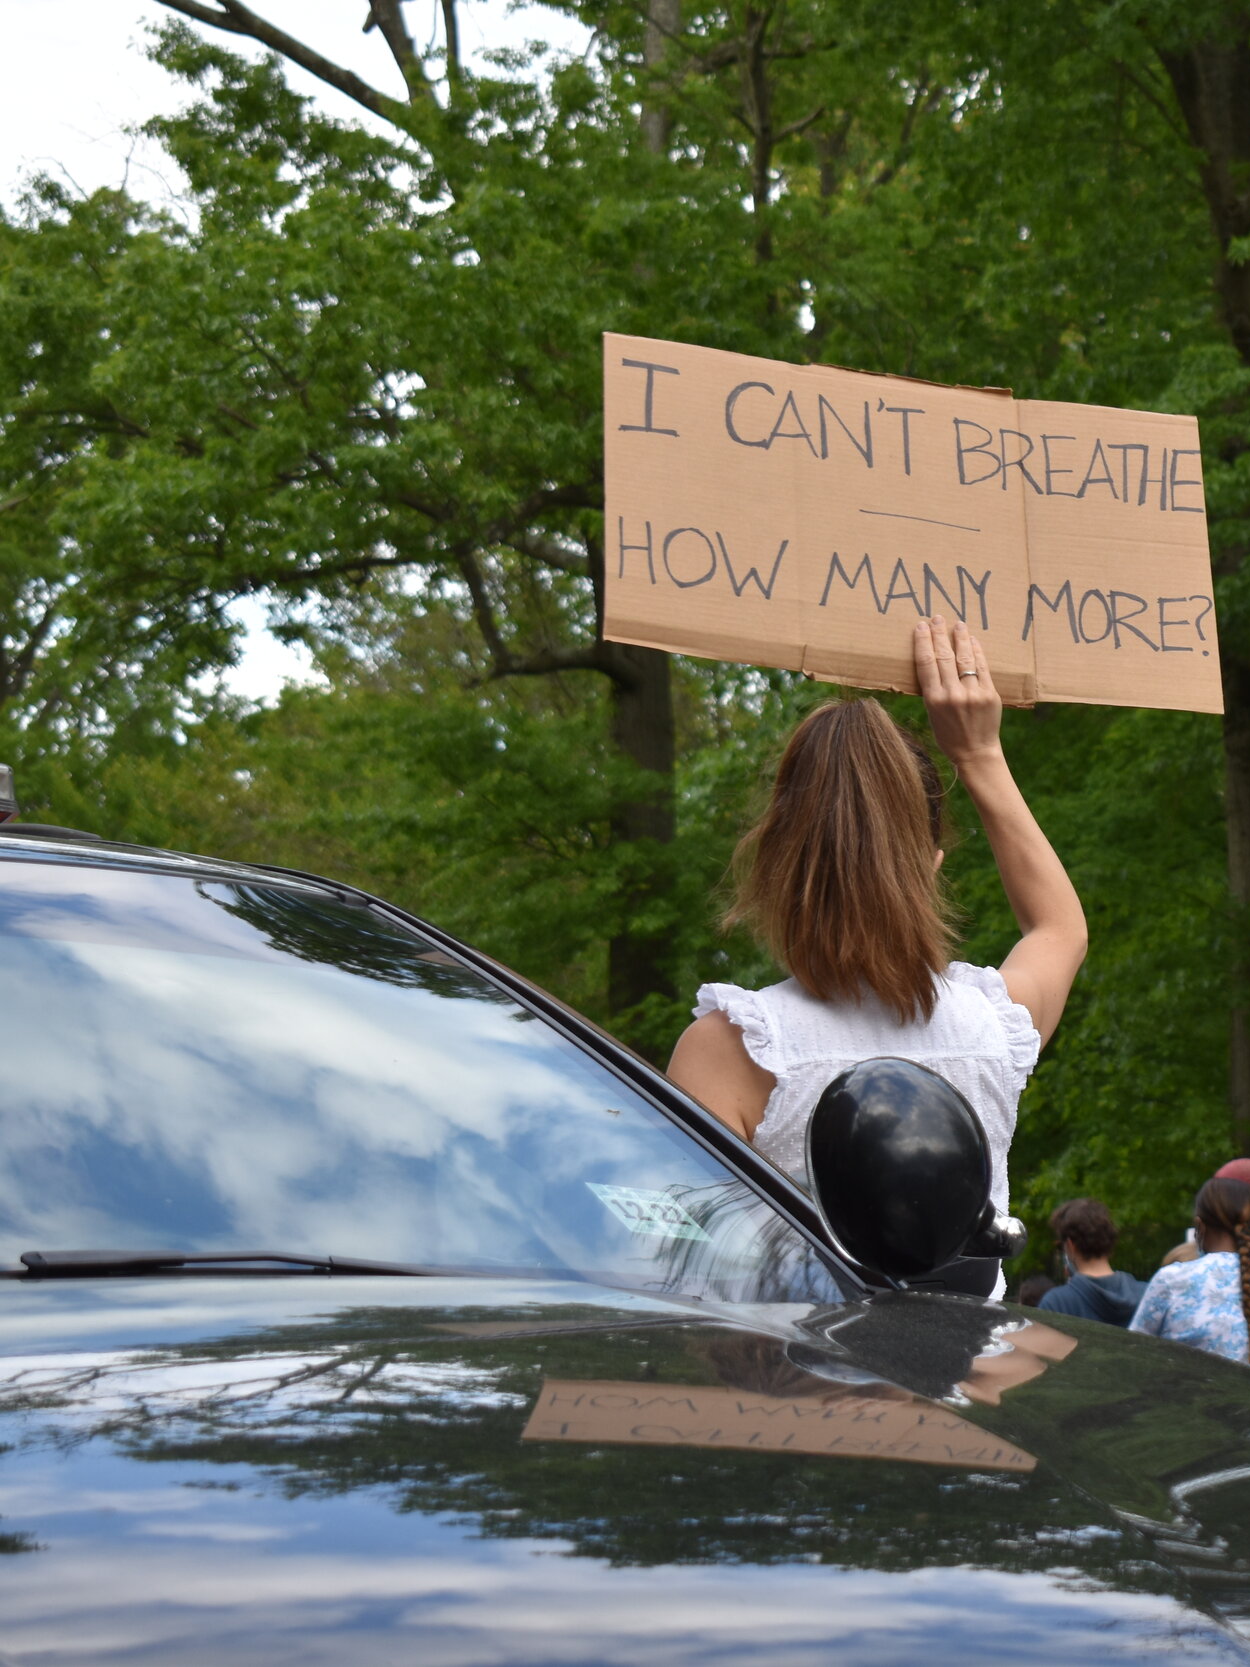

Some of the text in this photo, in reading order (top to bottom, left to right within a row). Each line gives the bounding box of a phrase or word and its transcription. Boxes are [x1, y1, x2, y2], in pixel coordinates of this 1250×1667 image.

[619, 358, 1206, 513] I CAN'T BREATHE
[618, 516, 1213, 657] HOW MANY MORE?
